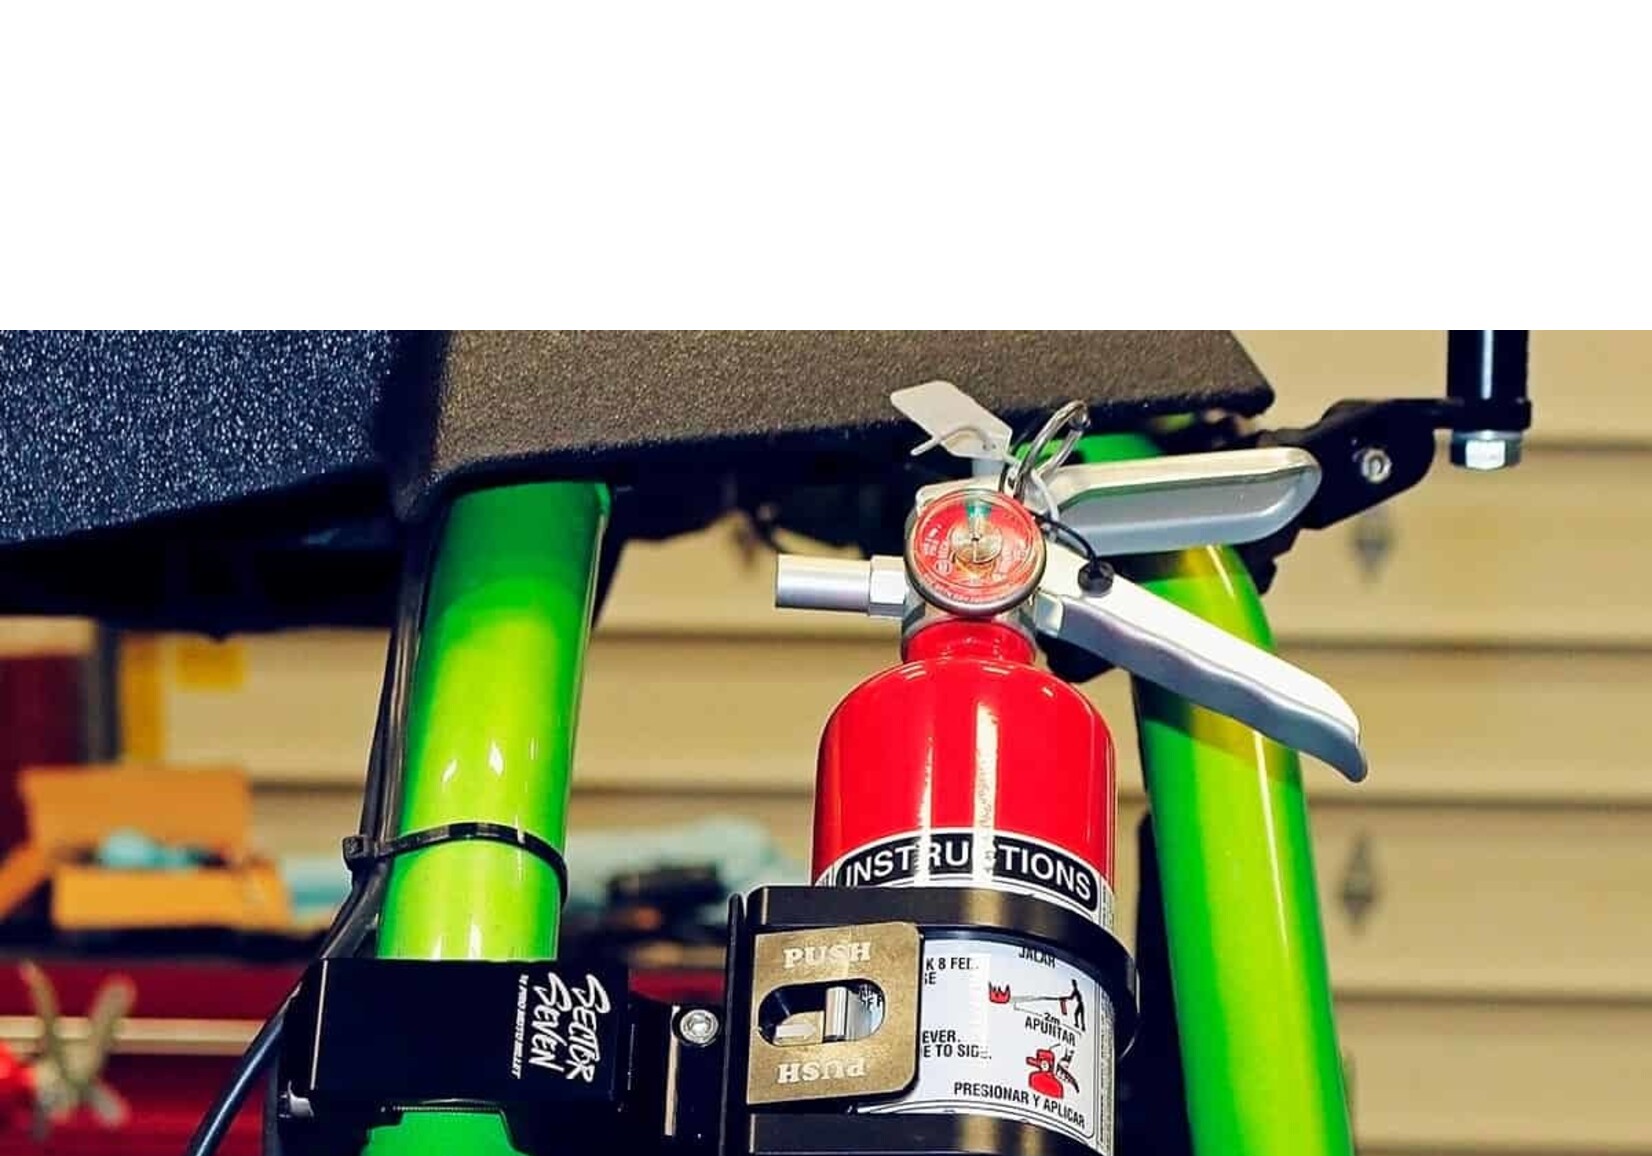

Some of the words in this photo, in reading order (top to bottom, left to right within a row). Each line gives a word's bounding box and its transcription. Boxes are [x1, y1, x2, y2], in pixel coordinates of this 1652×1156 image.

[845, 840, 1091, 901] INSTRUTIONS
[783, 942, 871, 968] PUSH
[938, 957, 947, 970] 8
[528, 972, 572, 1072] SEVEN
[566, 974, 611, 1082] SECTOR
[1025, 1015, 1075, 1046] APUNTAR
[1044, 1012, 1060, 1026] 2m
[922, 1029, 961, 1044] EVER.
[936, 1044, 953, 1058] TO
[777, 1057, 866, 1083] PUSH
[954, 1082, 1029, 1105] PRESIONAR
[1033, 1093, 1041, 1107] Y
[1043, 1099, 1085, 1129] APLICAR
